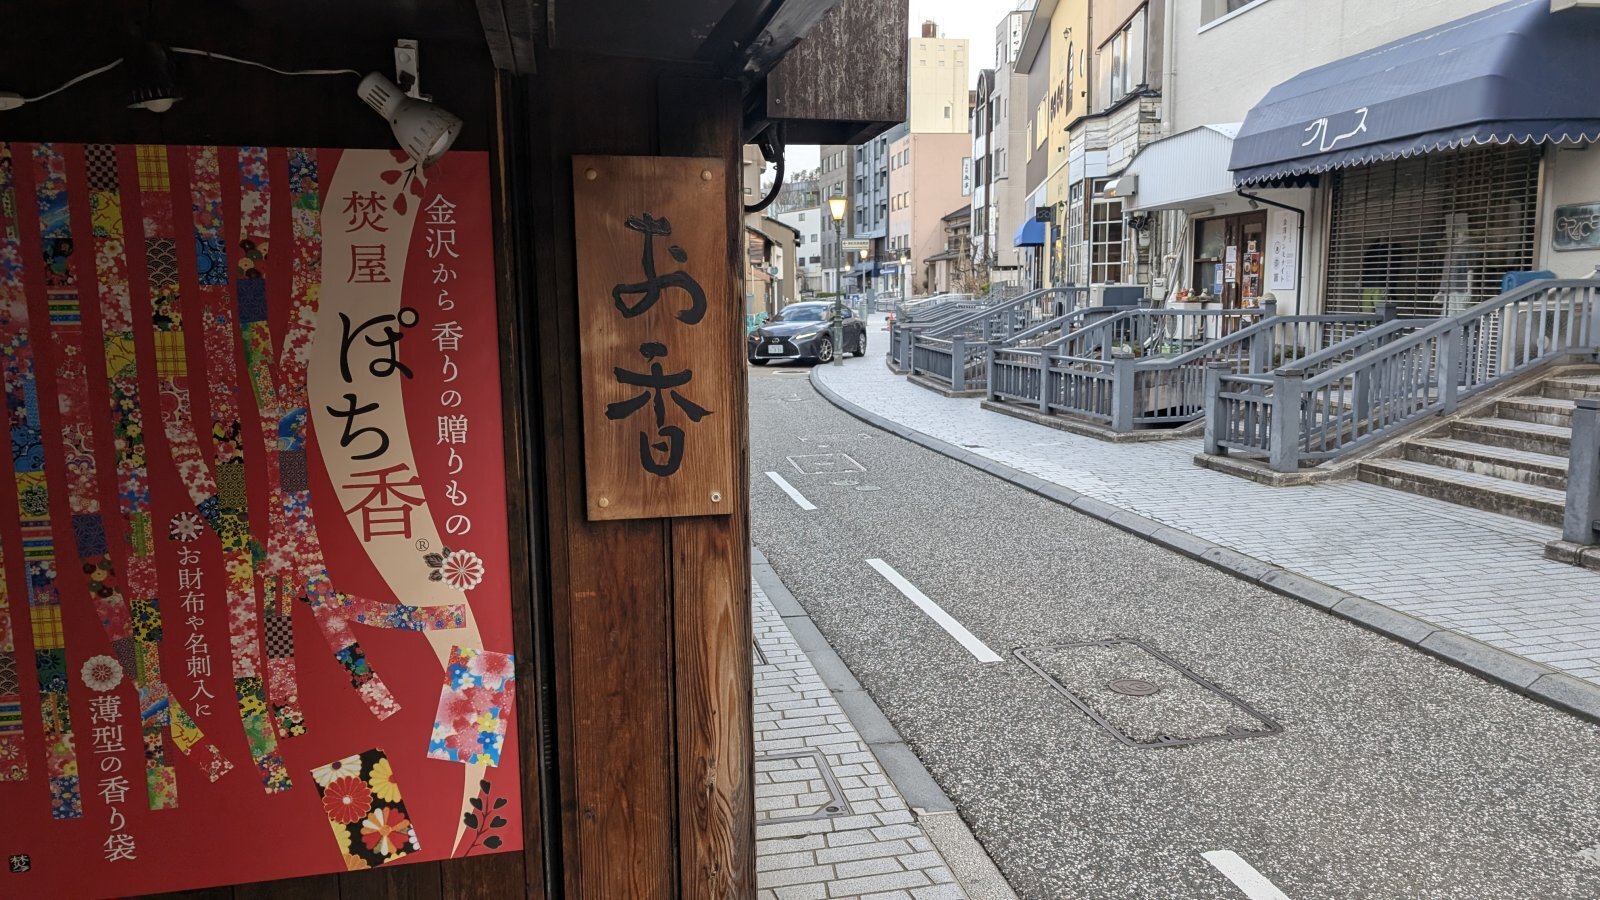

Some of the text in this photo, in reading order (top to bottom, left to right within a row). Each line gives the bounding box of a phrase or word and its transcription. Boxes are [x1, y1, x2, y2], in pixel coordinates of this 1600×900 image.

[326, 190, 426, 543] 焚屋 ぽち香
[424, 193, 471, 536] 金沢から香りの贈りもの
[604, 212, 715, 478] お香
[176, 545, 215, 718] お財布や名刺入に
[88, 695, 138, 863] 薄型の香り袋
